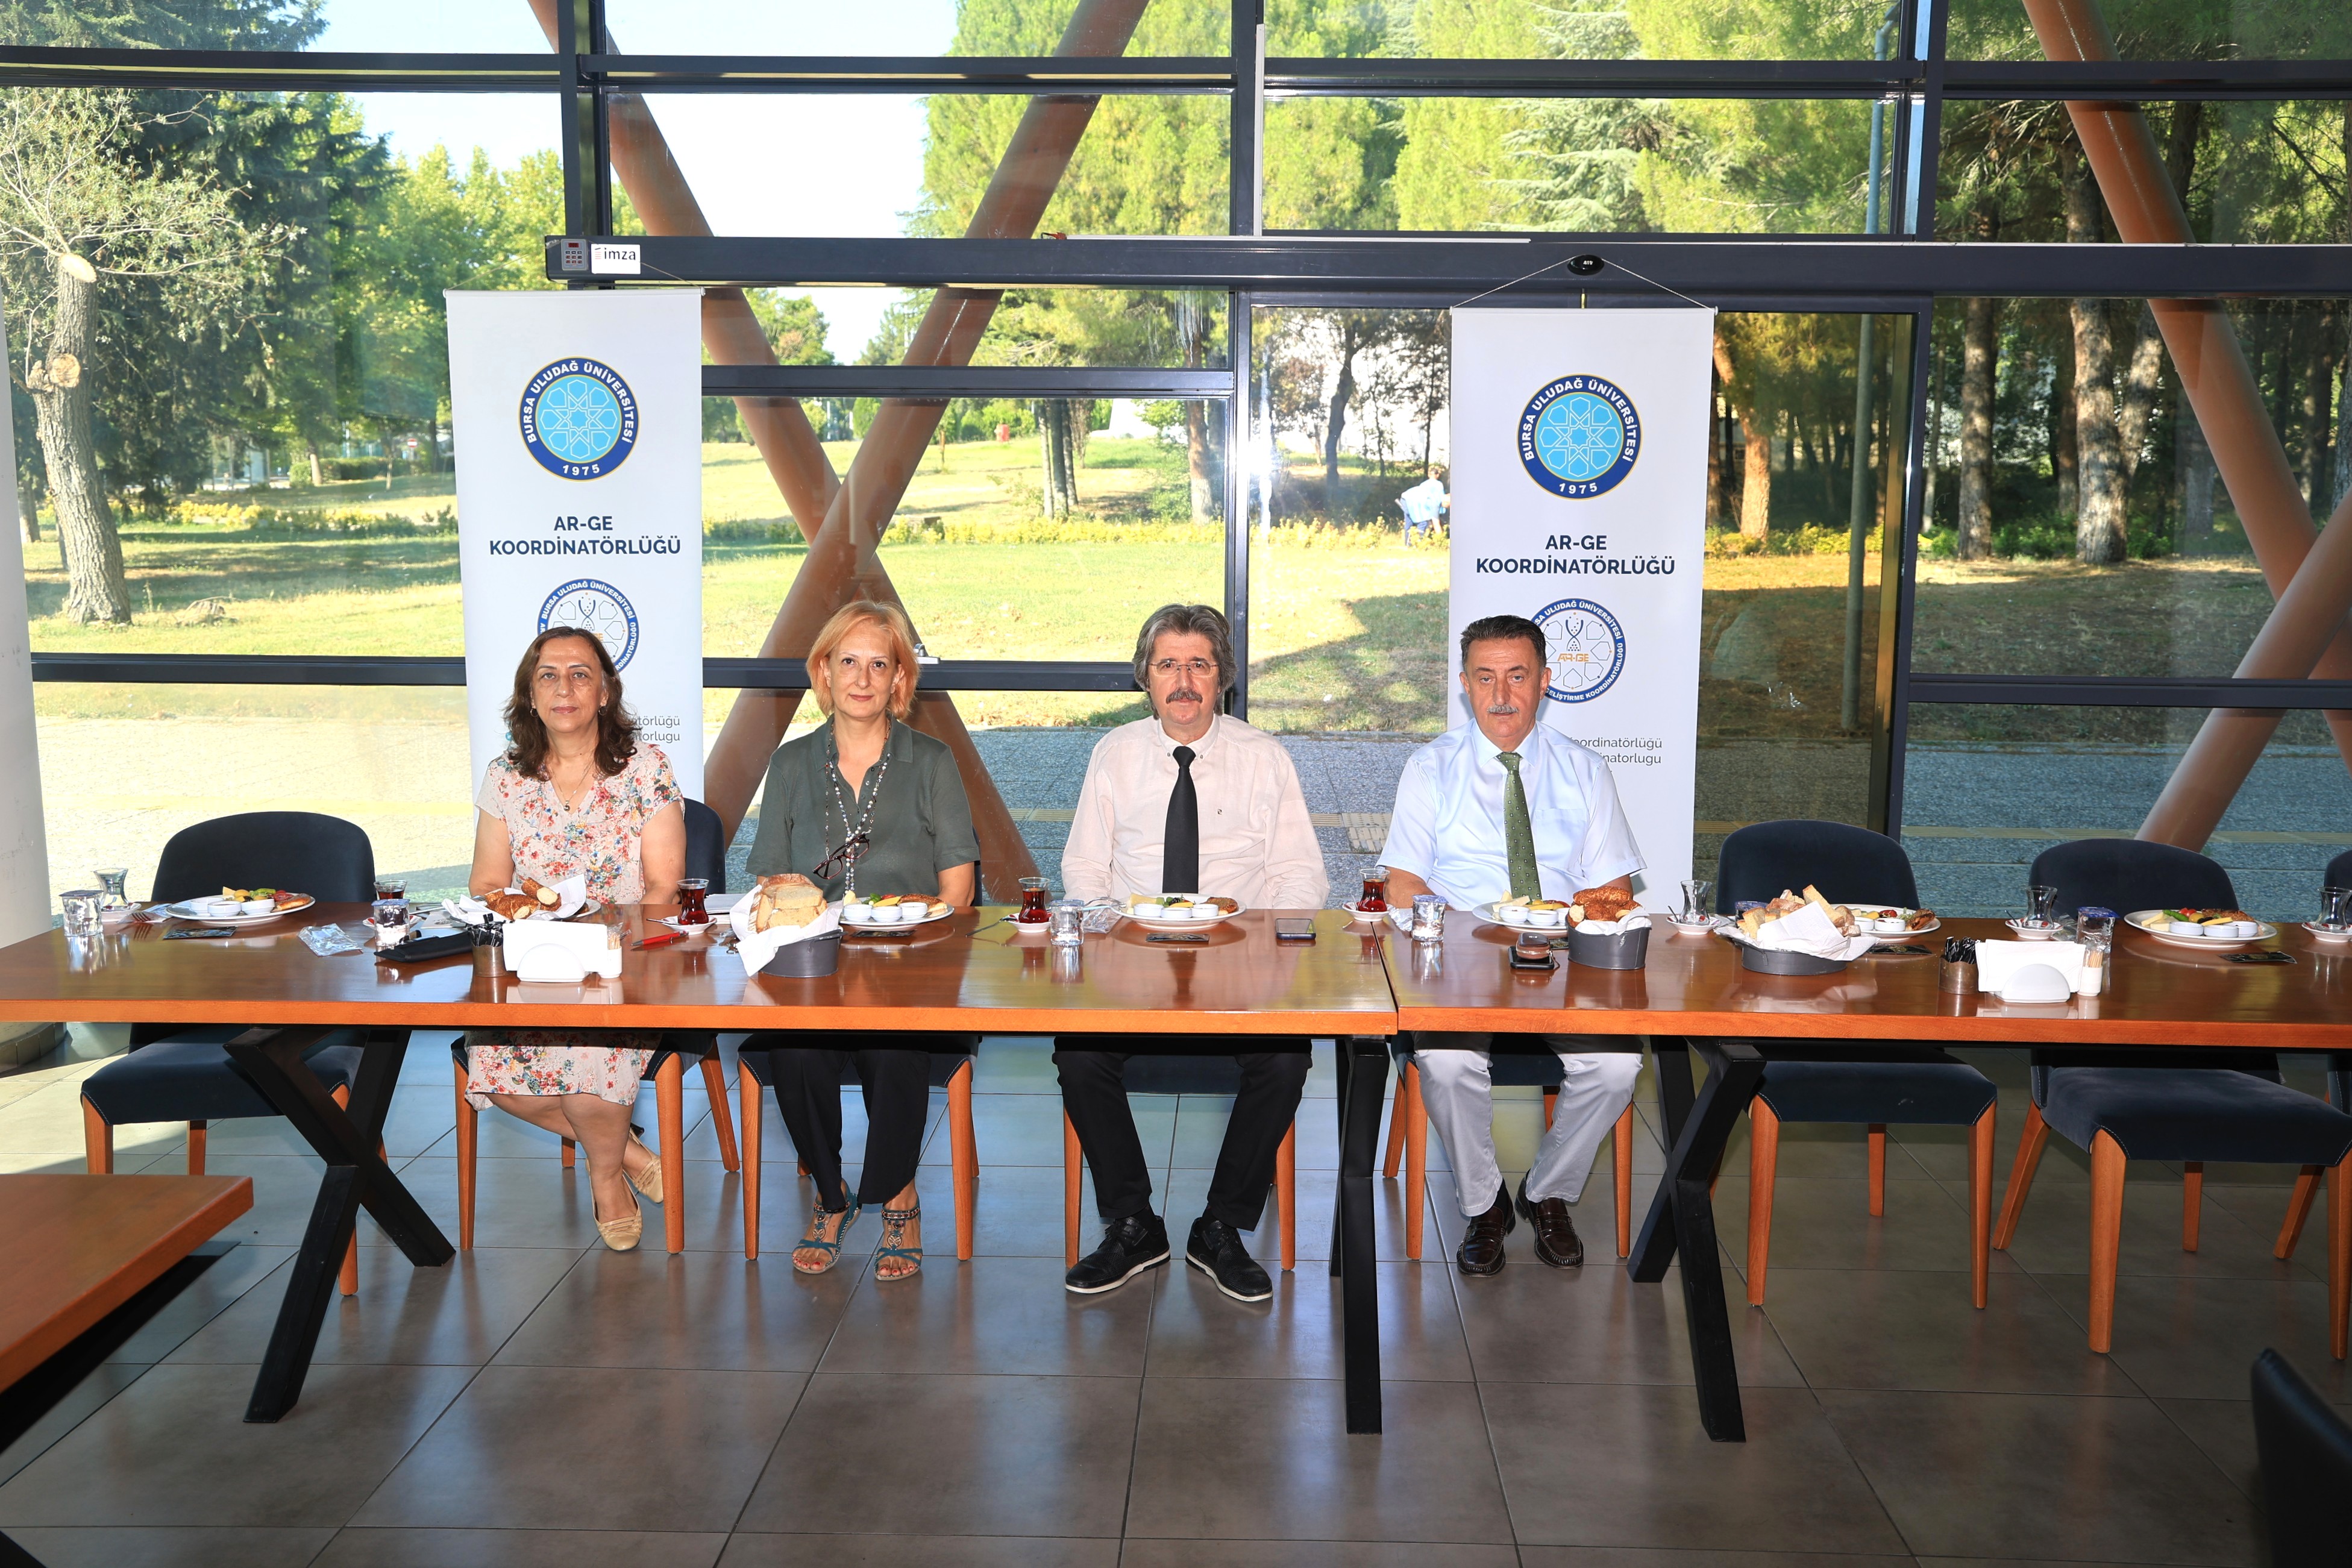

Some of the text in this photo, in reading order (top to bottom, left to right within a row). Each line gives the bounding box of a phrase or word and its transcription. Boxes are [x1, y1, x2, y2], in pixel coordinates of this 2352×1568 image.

[604, 247, 636, 260] imza
[523, 360, 634, 444] BURSA ULUDAĞ ÜNİVERSİTESİ
[1522, 377, 1637, 462] BURSA ULUDAĞ ÜNİVERSİTESİ
[562, 463, 600, 476] 1975
[1559, 482, 1598, 494] 1975
[554, 516, 613, 531] AR-GE
[489, 536, 681, 555] KOORDİNATÖRLÜĞÜ
[1545, 535, 1607, 550] AR-GE
[1476, 554, 1675, 574] KOORDİNATÖRLÜĞÜ
[541, 580, 635, 620] BURSA ULUDAĞ ÜNİVERSİTESİ
[1544, 600, 1577, 616] ULUDAĞ
[1579, 600, 1623, 639] ÜNİVERSİTESİ
[1585, 642, 1624, 699] KOORDİNATÖRLÜĞÜ
